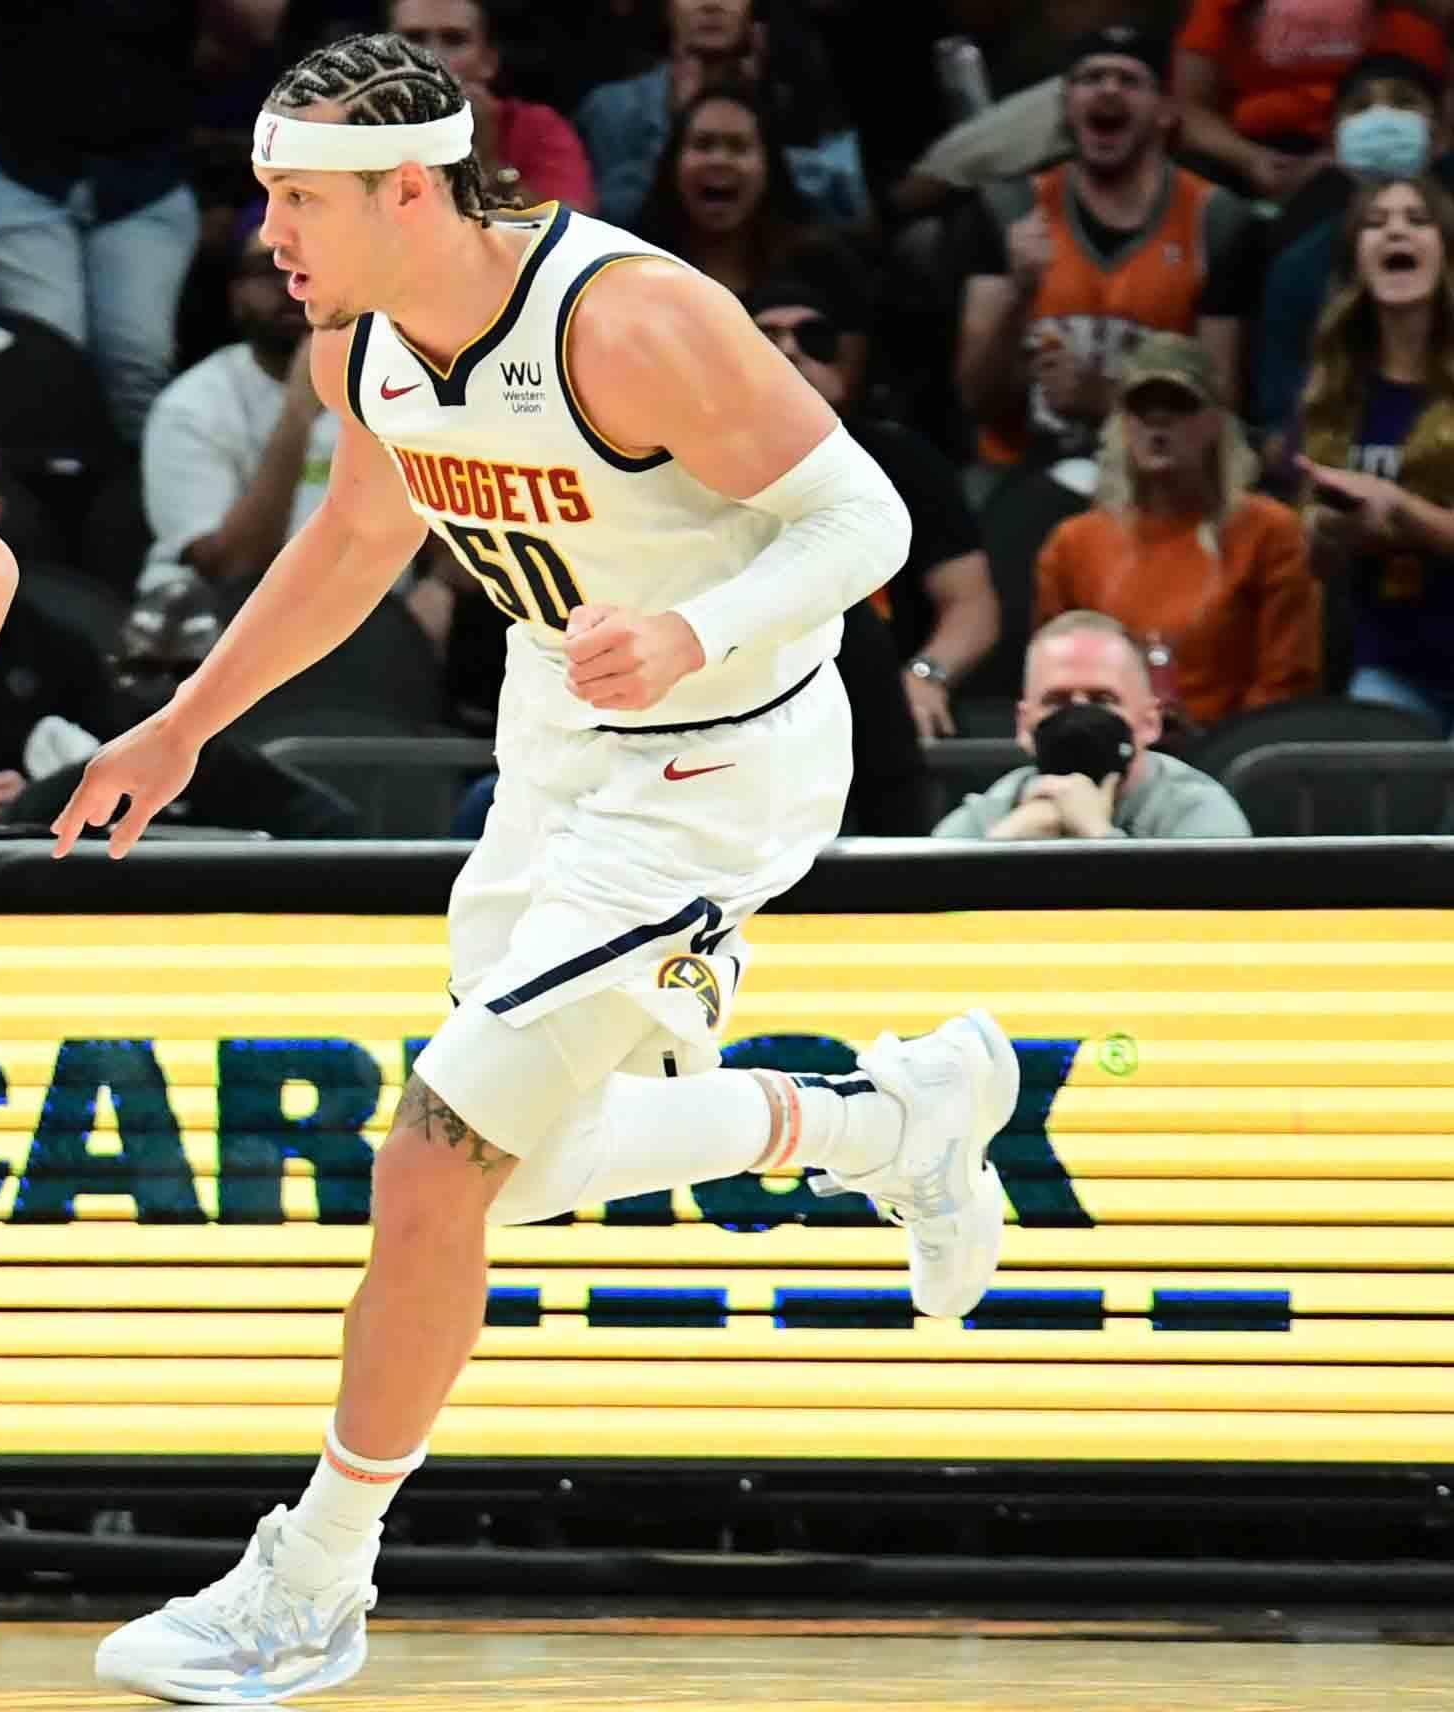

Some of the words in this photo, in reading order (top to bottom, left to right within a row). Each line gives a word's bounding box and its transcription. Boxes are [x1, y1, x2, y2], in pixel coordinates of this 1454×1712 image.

[499, 361, 542, 386] WU
[502, 391, 546, 401] Western
[511, 402, 542, 414] Union
[393, 447, 592, 523] NUGGETS
[442, 520, 584, 633] 50
